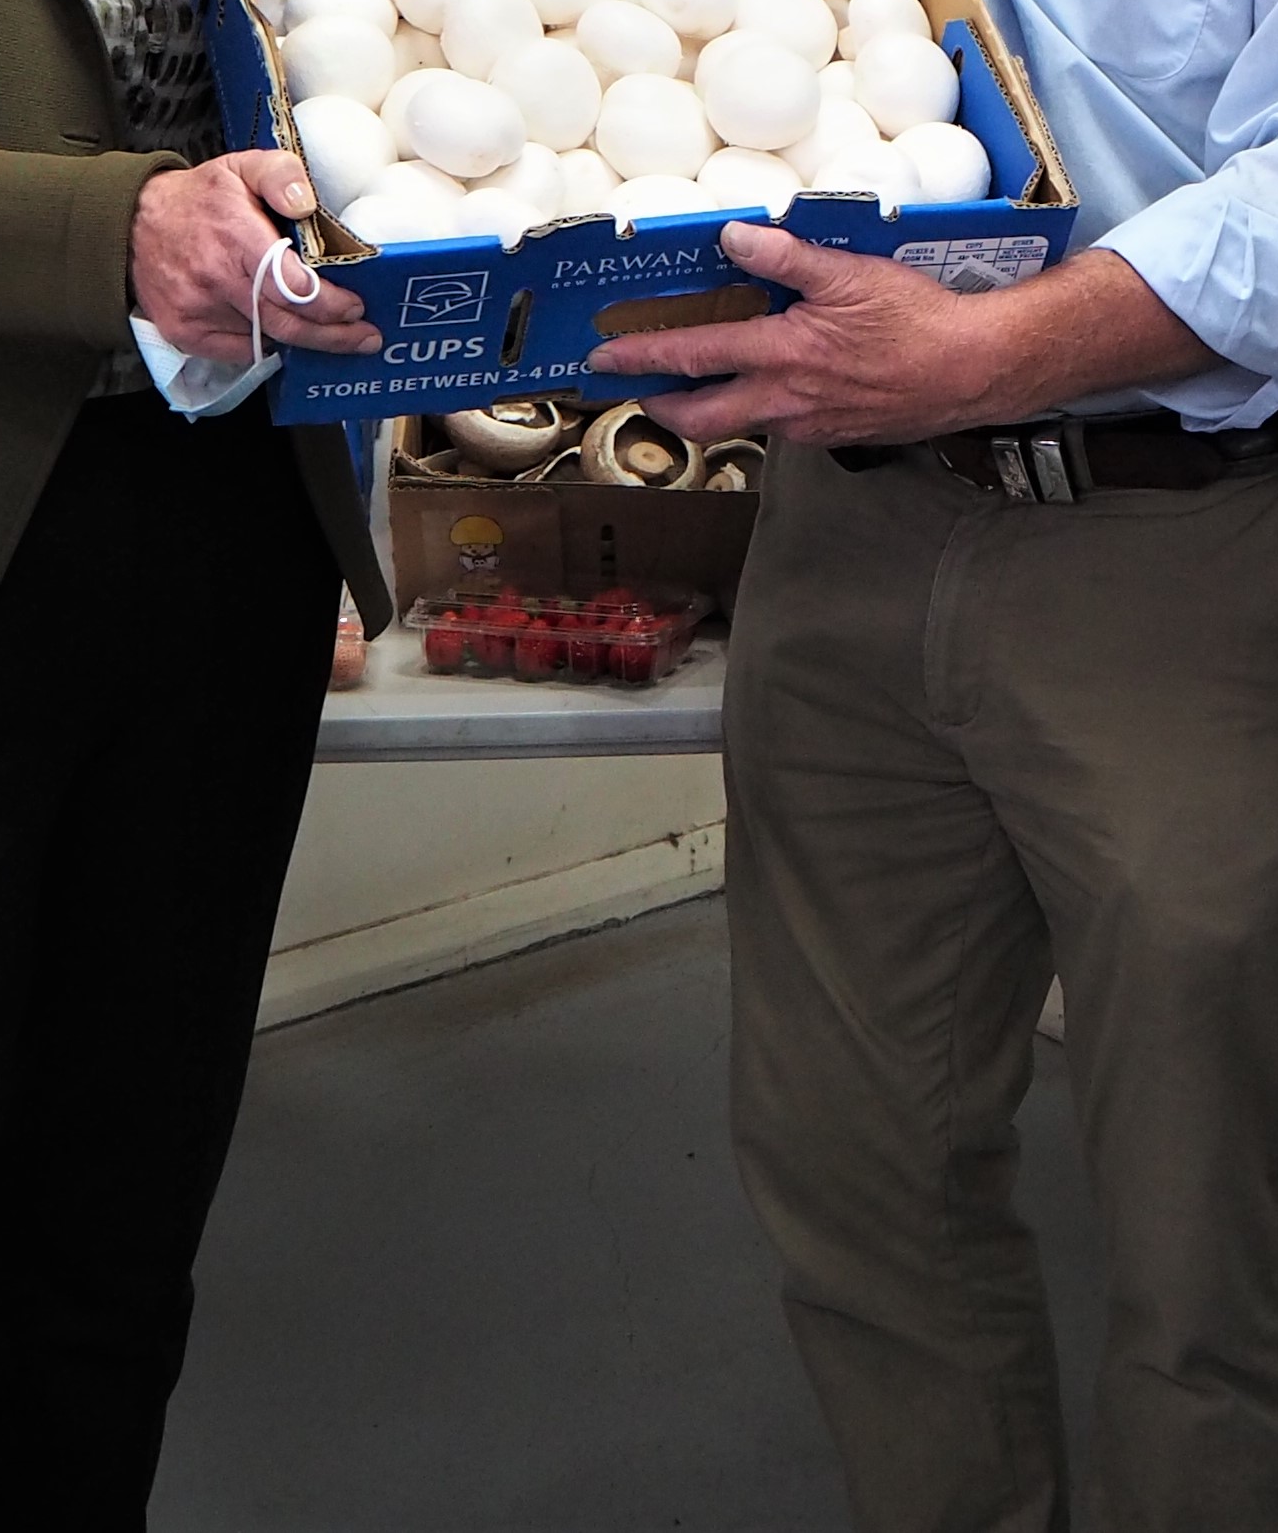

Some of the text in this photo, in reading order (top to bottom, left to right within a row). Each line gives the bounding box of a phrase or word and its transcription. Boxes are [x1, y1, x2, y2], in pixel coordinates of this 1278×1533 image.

[552, 278, 587, 289] new
[597, 266, 704, 287] generation
[553, 248, 701, 279] PARWAN
[383, 336, 486, 364] CUPS
[306, 379, 382, 400] STORE
[388, 370, 500, 393] BETWEEN
[505, 365, 543, 384] 2-4
